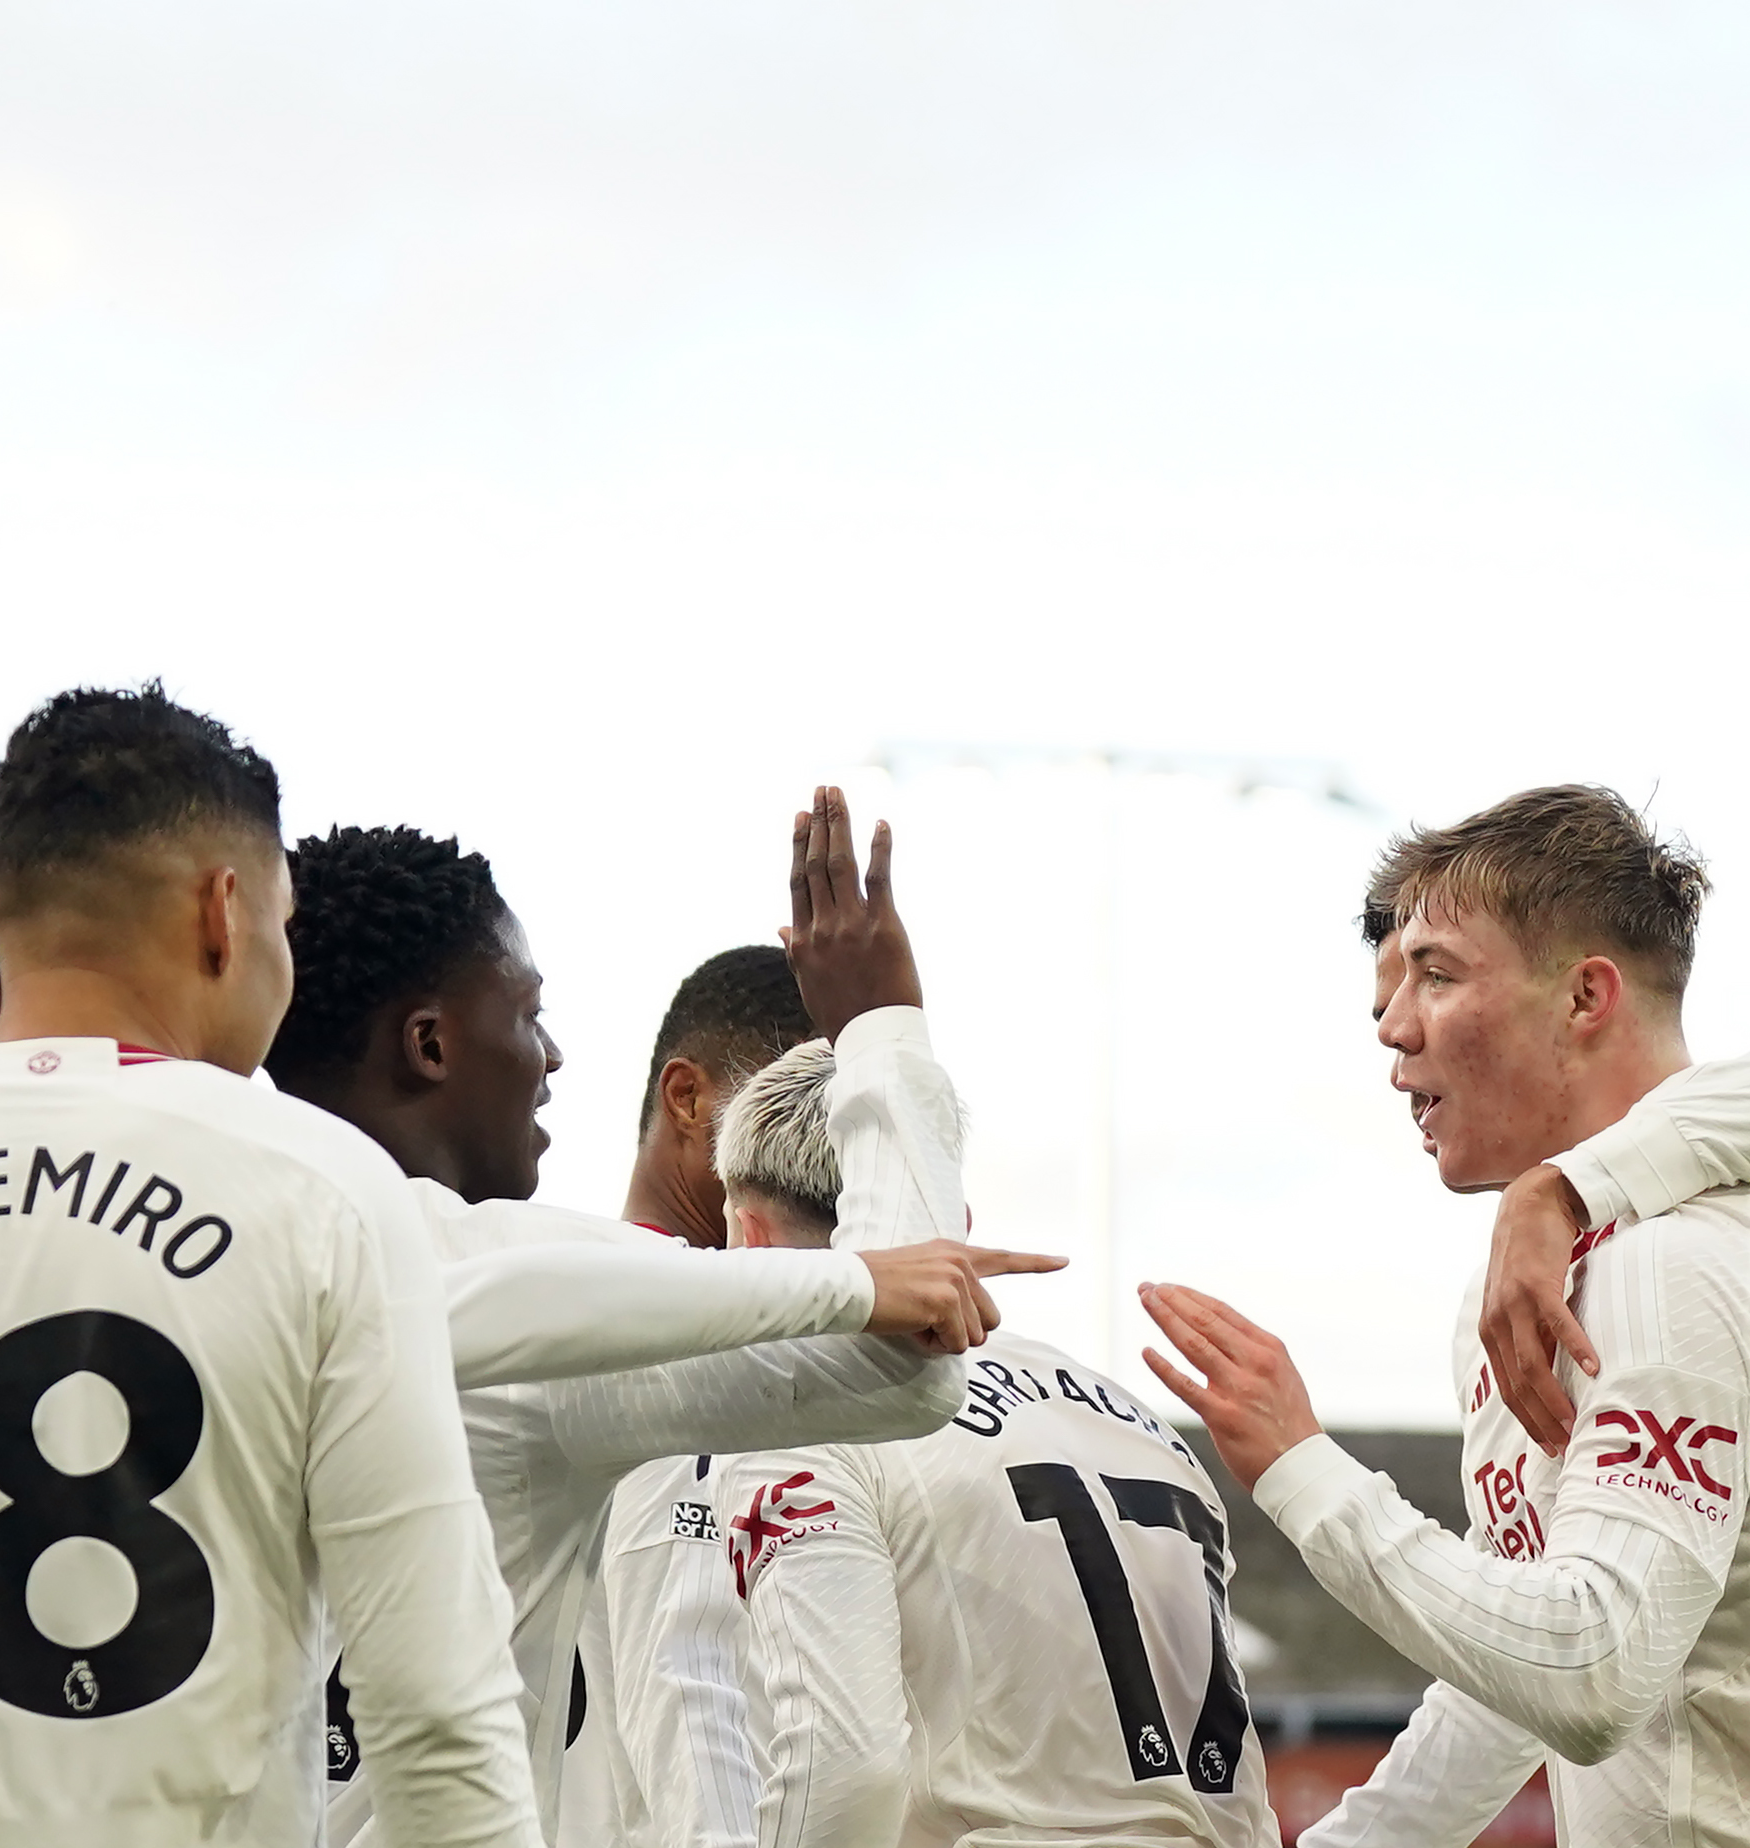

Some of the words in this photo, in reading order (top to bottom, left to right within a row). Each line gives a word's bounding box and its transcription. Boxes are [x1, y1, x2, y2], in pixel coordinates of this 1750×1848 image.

[1594, 1409, 1738, 1502] DXC
[1595, 1472, 1729, 1528] TECHNOLOGY
[1006, 1461, 1249, 1795] 17
